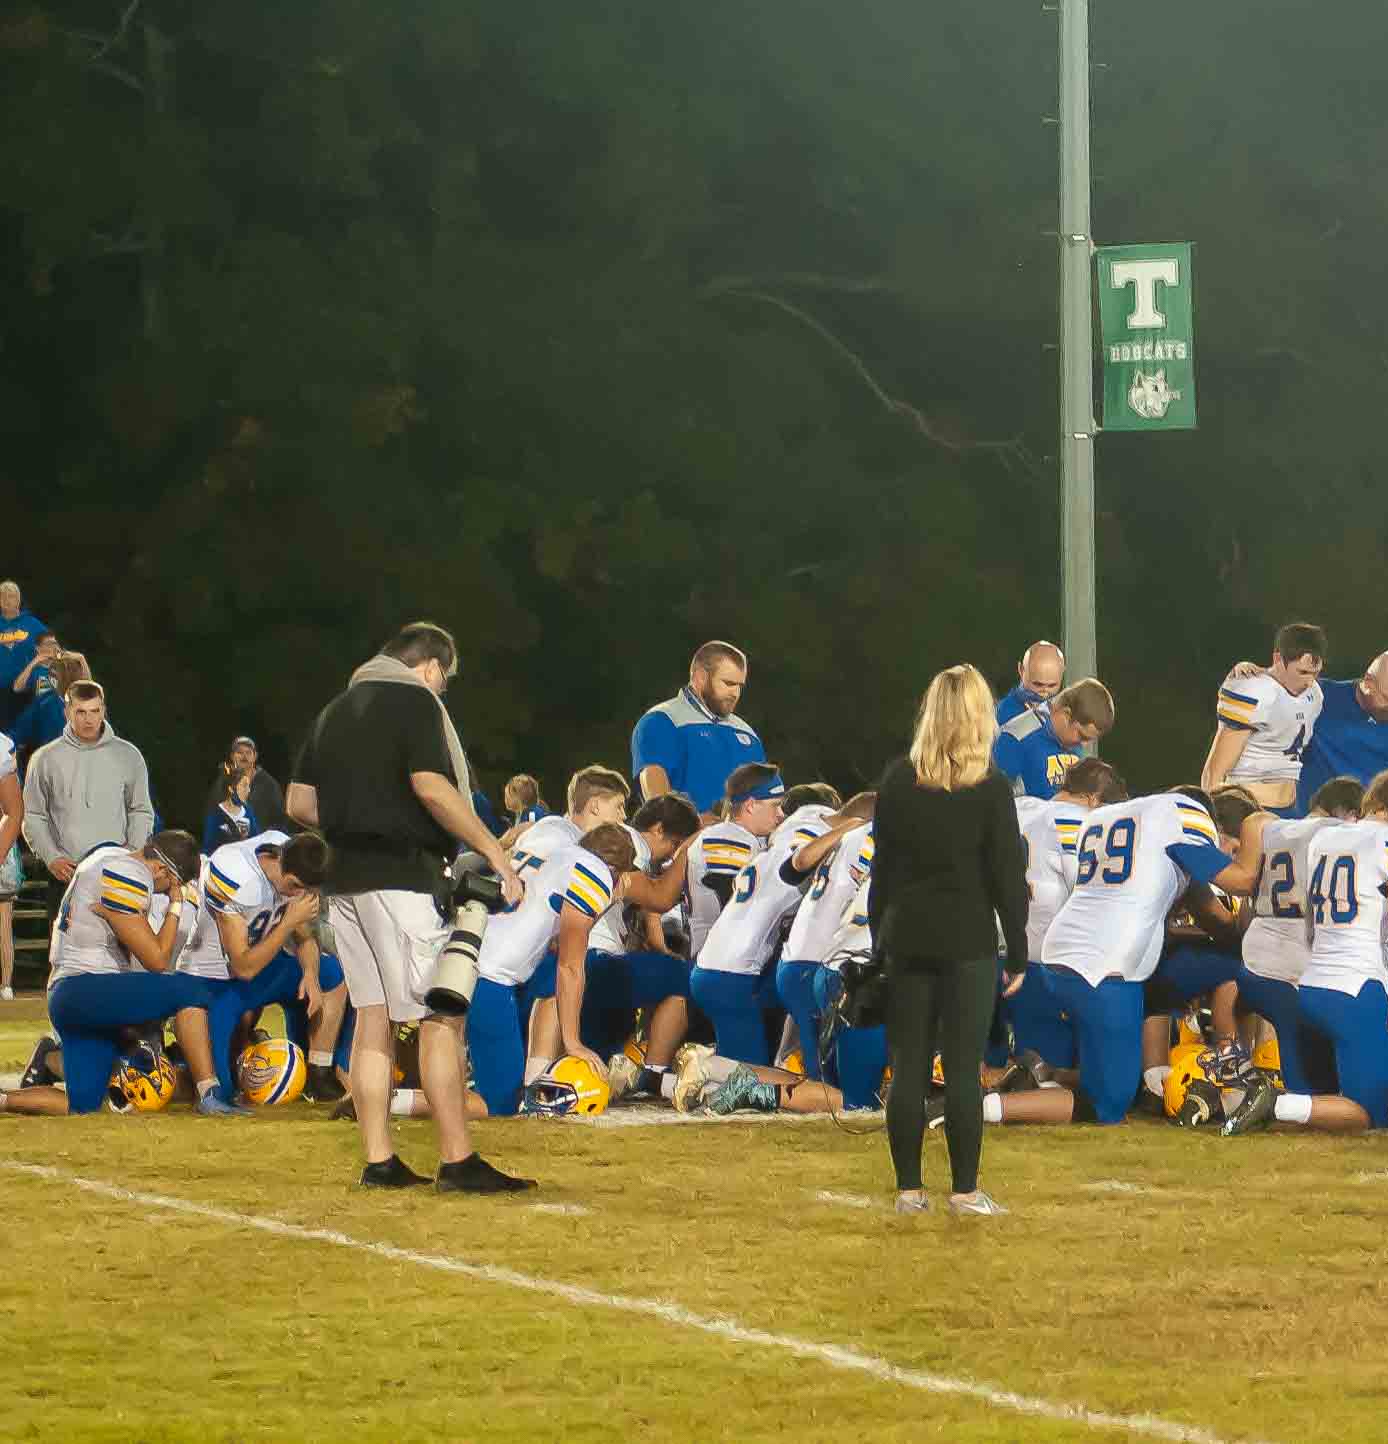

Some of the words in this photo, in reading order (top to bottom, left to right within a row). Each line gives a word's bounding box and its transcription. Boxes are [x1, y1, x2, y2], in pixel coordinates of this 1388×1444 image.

[1110, 259, 1179, 329] T
[1110, 342, 1186, 363] BOBCATS
[1076, 817, 1136, 885] 69
[1309, 854, 1358, 924] 40
